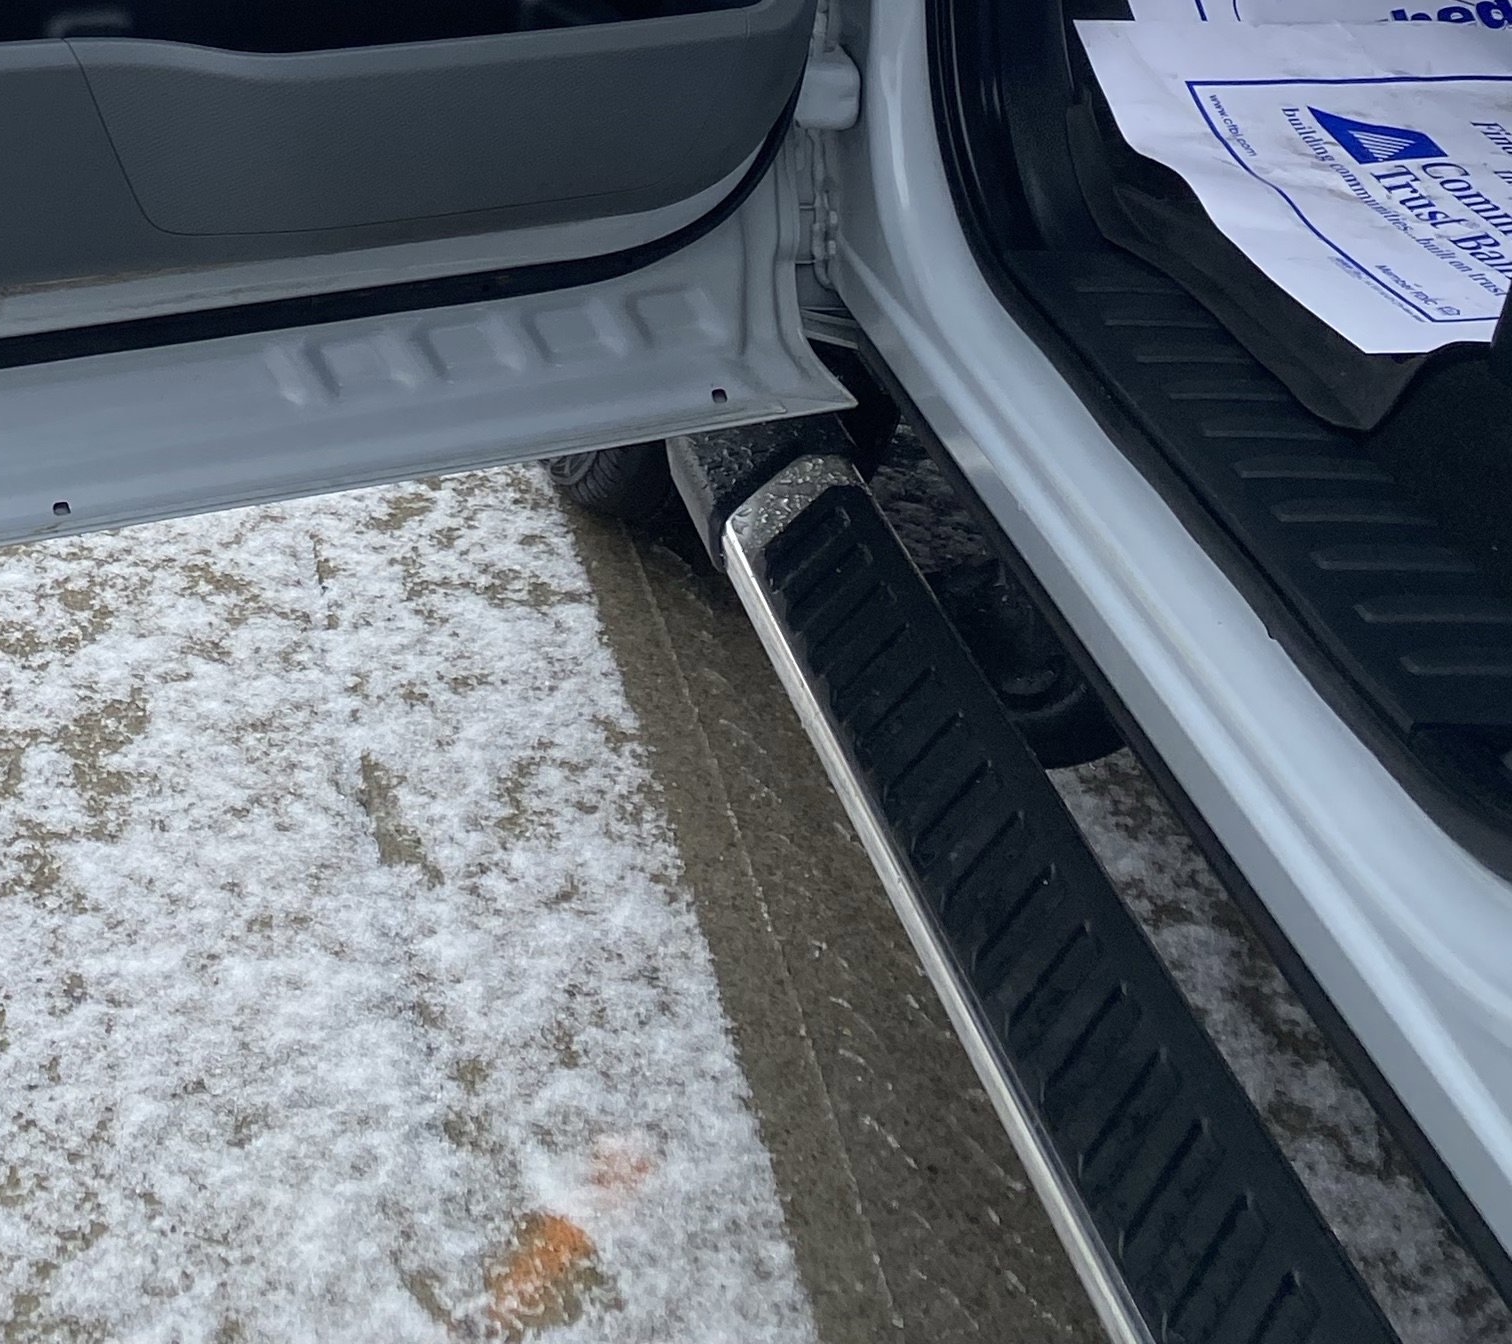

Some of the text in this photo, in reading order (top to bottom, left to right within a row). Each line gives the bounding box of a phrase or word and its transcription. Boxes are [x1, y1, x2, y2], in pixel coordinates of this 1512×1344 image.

[1281, 107, 1336, 162] building
[1449, 260, 1473, 272] on
[1468, 273, 1508, 297] trust
[1370, 165, 1468, 230] Trust
